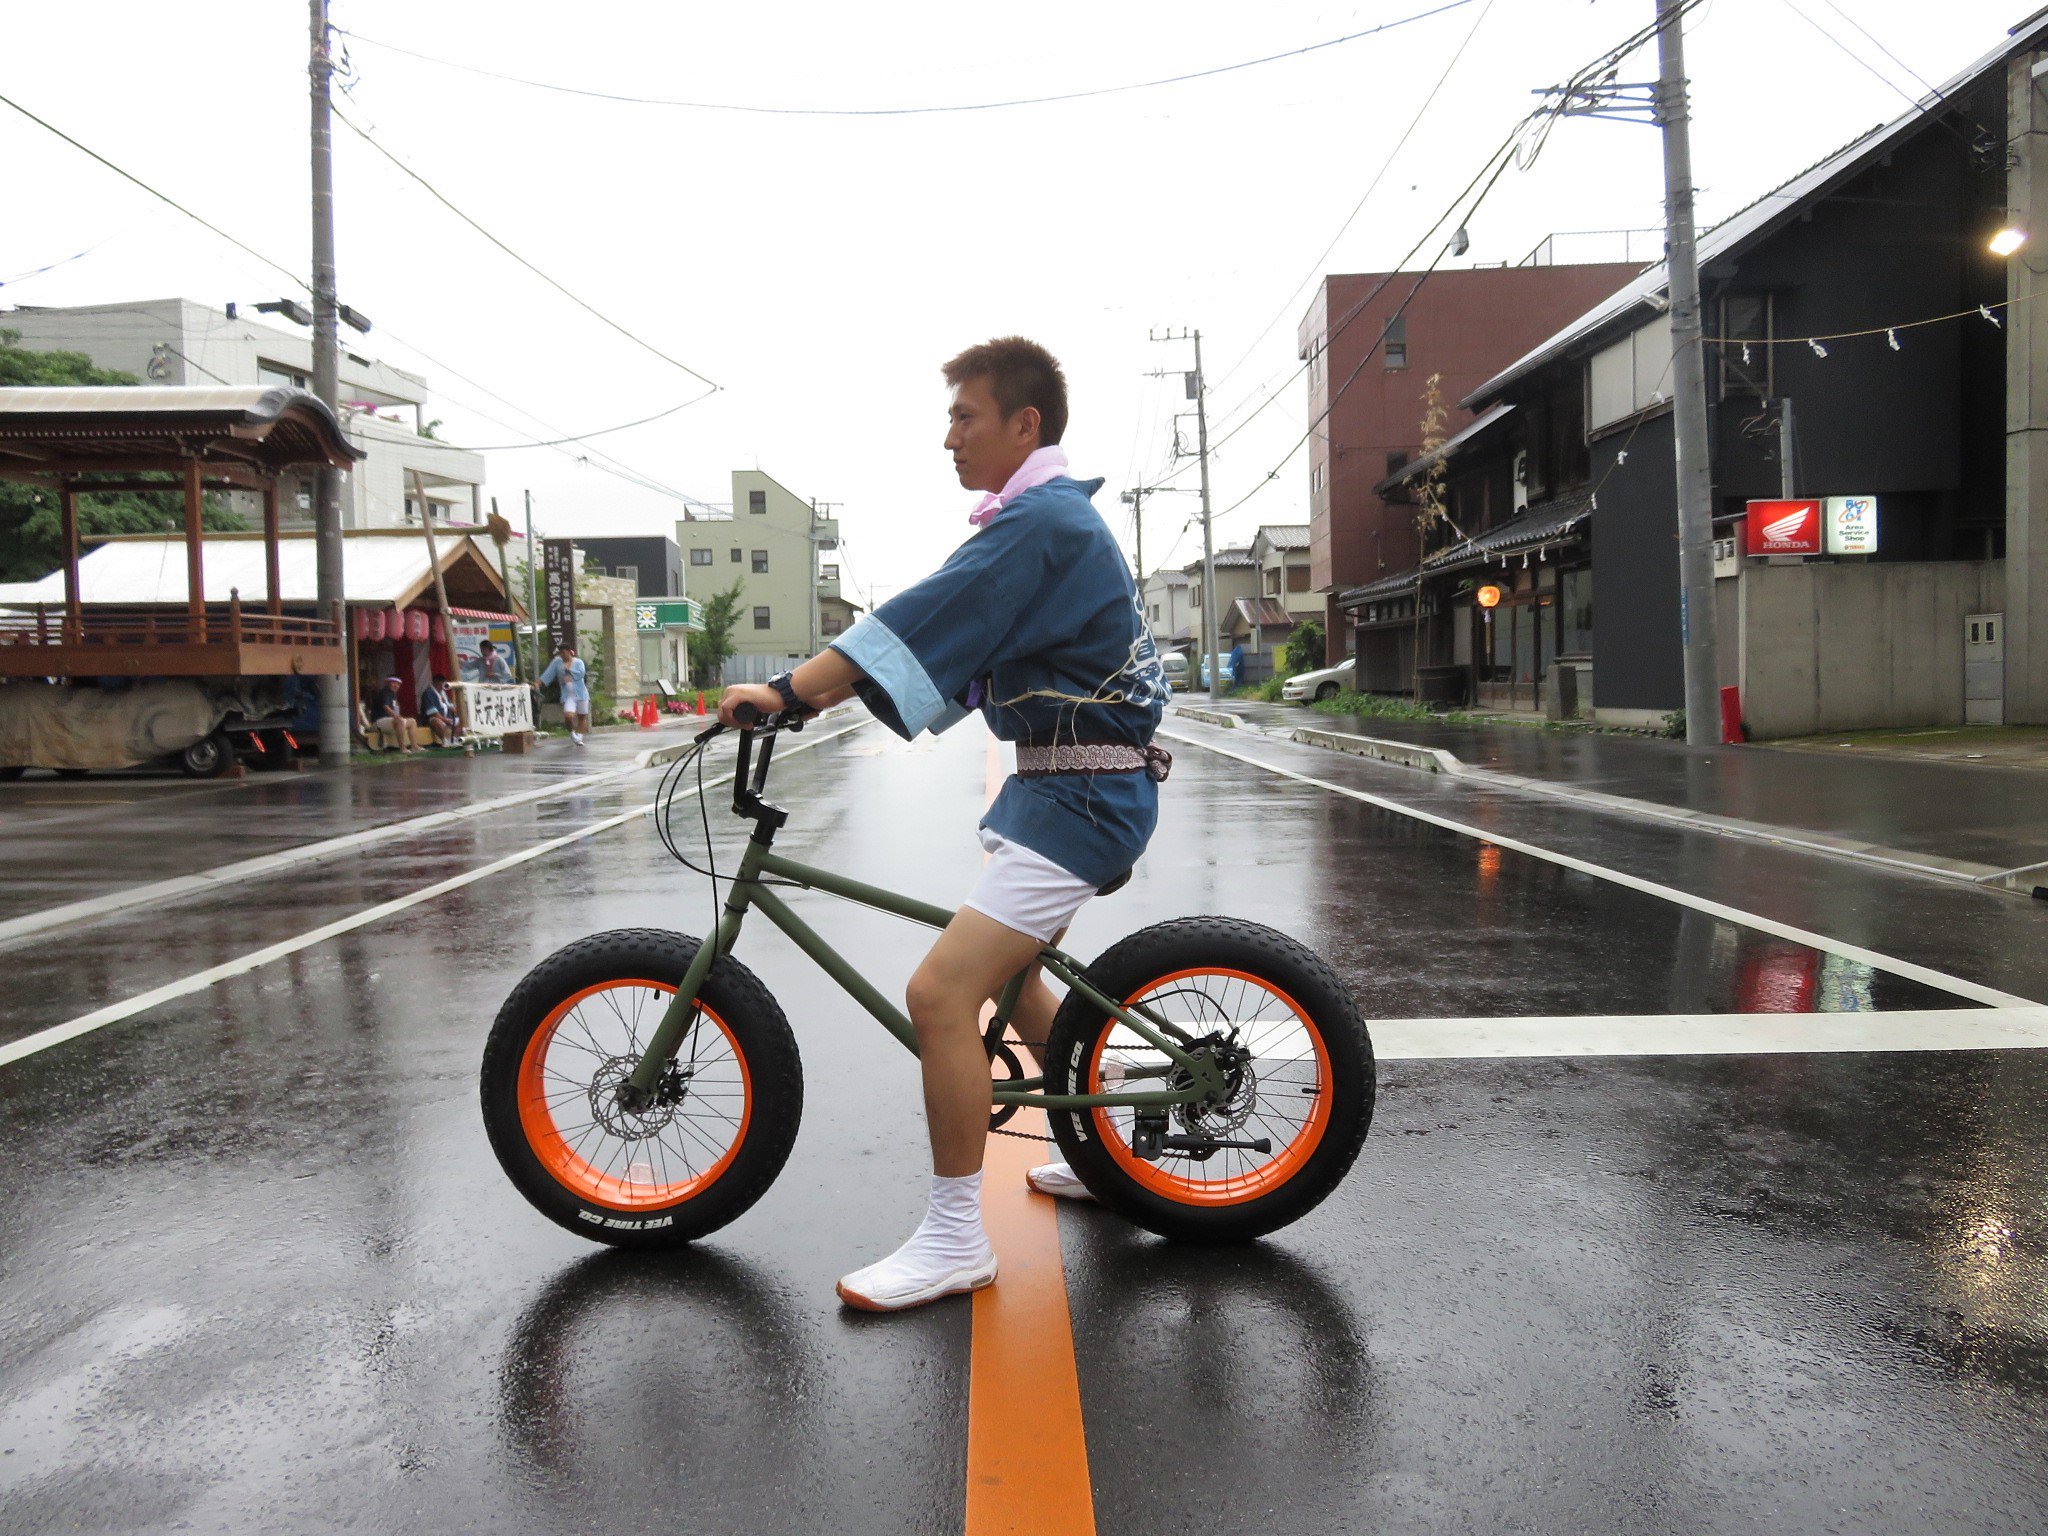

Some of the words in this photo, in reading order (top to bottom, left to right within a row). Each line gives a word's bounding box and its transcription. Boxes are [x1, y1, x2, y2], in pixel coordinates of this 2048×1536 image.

[1763, 541, 1809, 549] HONDA
[603, 1218, 643, 1230] TIRE
[644, 1216, 673, 1230] VEE
